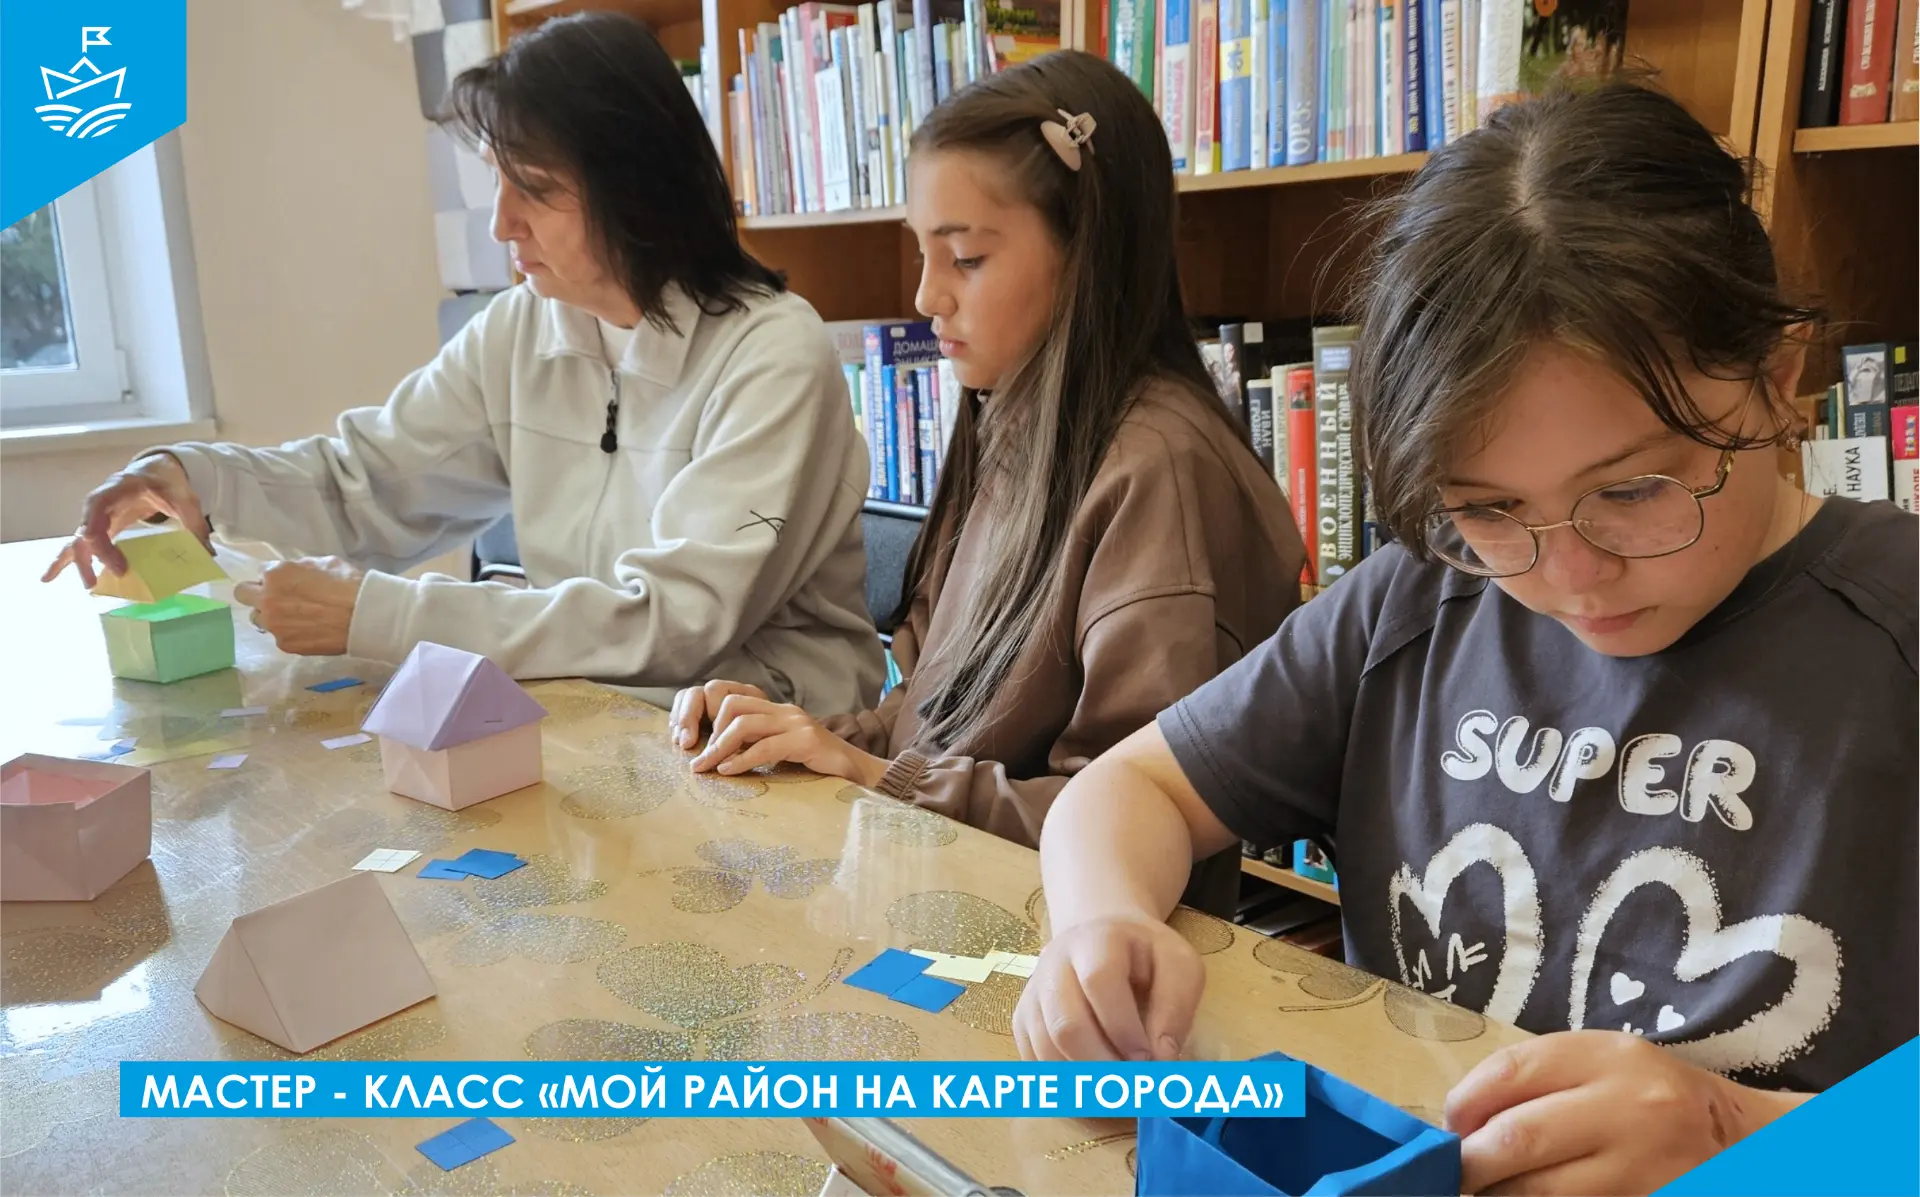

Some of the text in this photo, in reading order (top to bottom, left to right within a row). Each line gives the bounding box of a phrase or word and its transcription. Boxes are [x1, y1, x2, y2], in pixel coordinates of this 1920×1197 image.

[893, 339, 940, 355] ДОМАШ
[1261, 409, 1273, 448] ИВАН
[1317, 382, 1337, 559] ВОЕННЫЙ
[1844, 447, 1862, 492] НАУКА
[1440, 708, 1756, 831] SUPER
